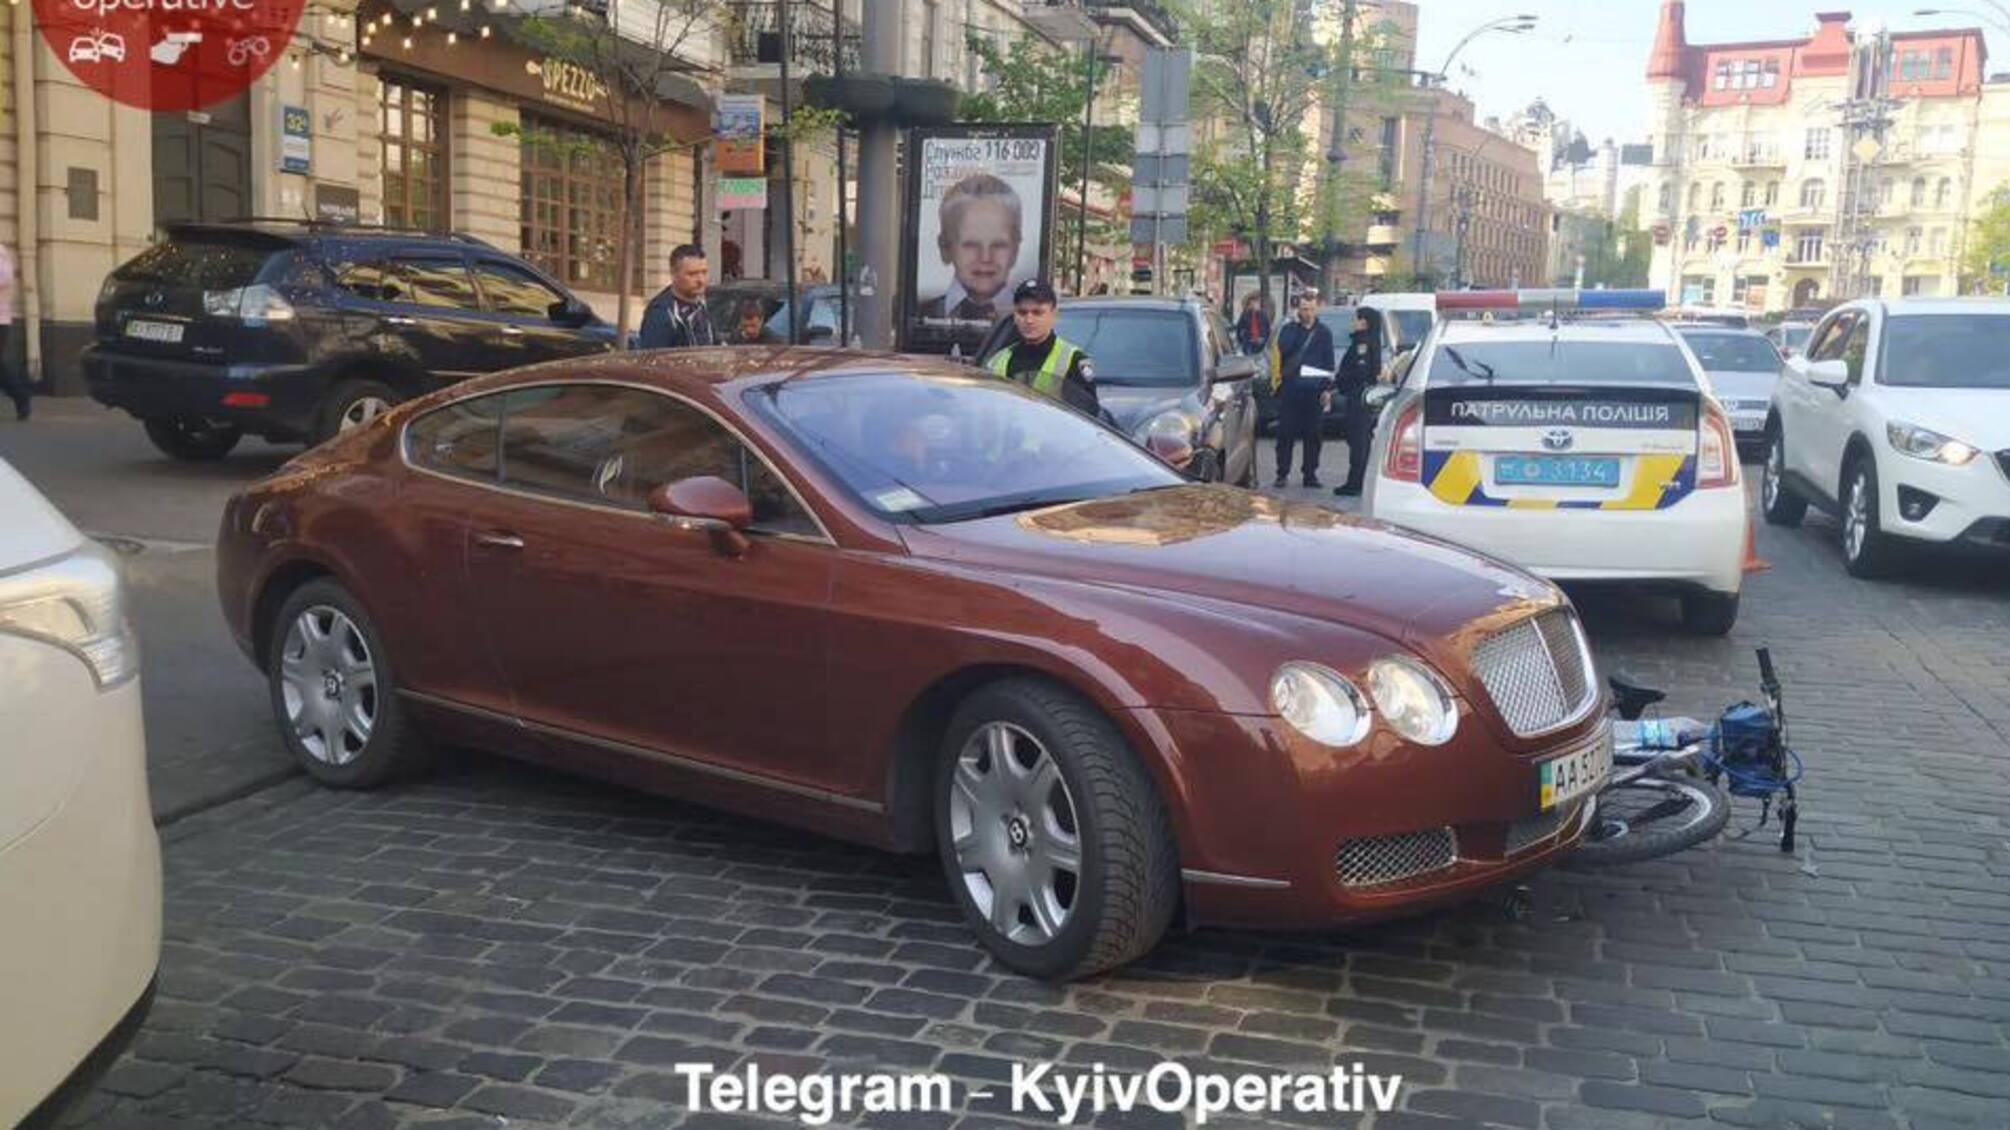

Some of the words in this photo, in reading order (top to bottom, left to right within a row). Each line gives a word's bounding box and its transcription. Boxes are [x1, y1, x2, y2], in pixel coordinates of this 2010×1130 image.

[985, 140, 1010, 161] 116
[1451, 402, 1576, 421] ПАТРУЛЬНА
[1583, 406, 1669, 421] ПОЛІЦІЯ
[1555, 759, 1577, 796] AA
